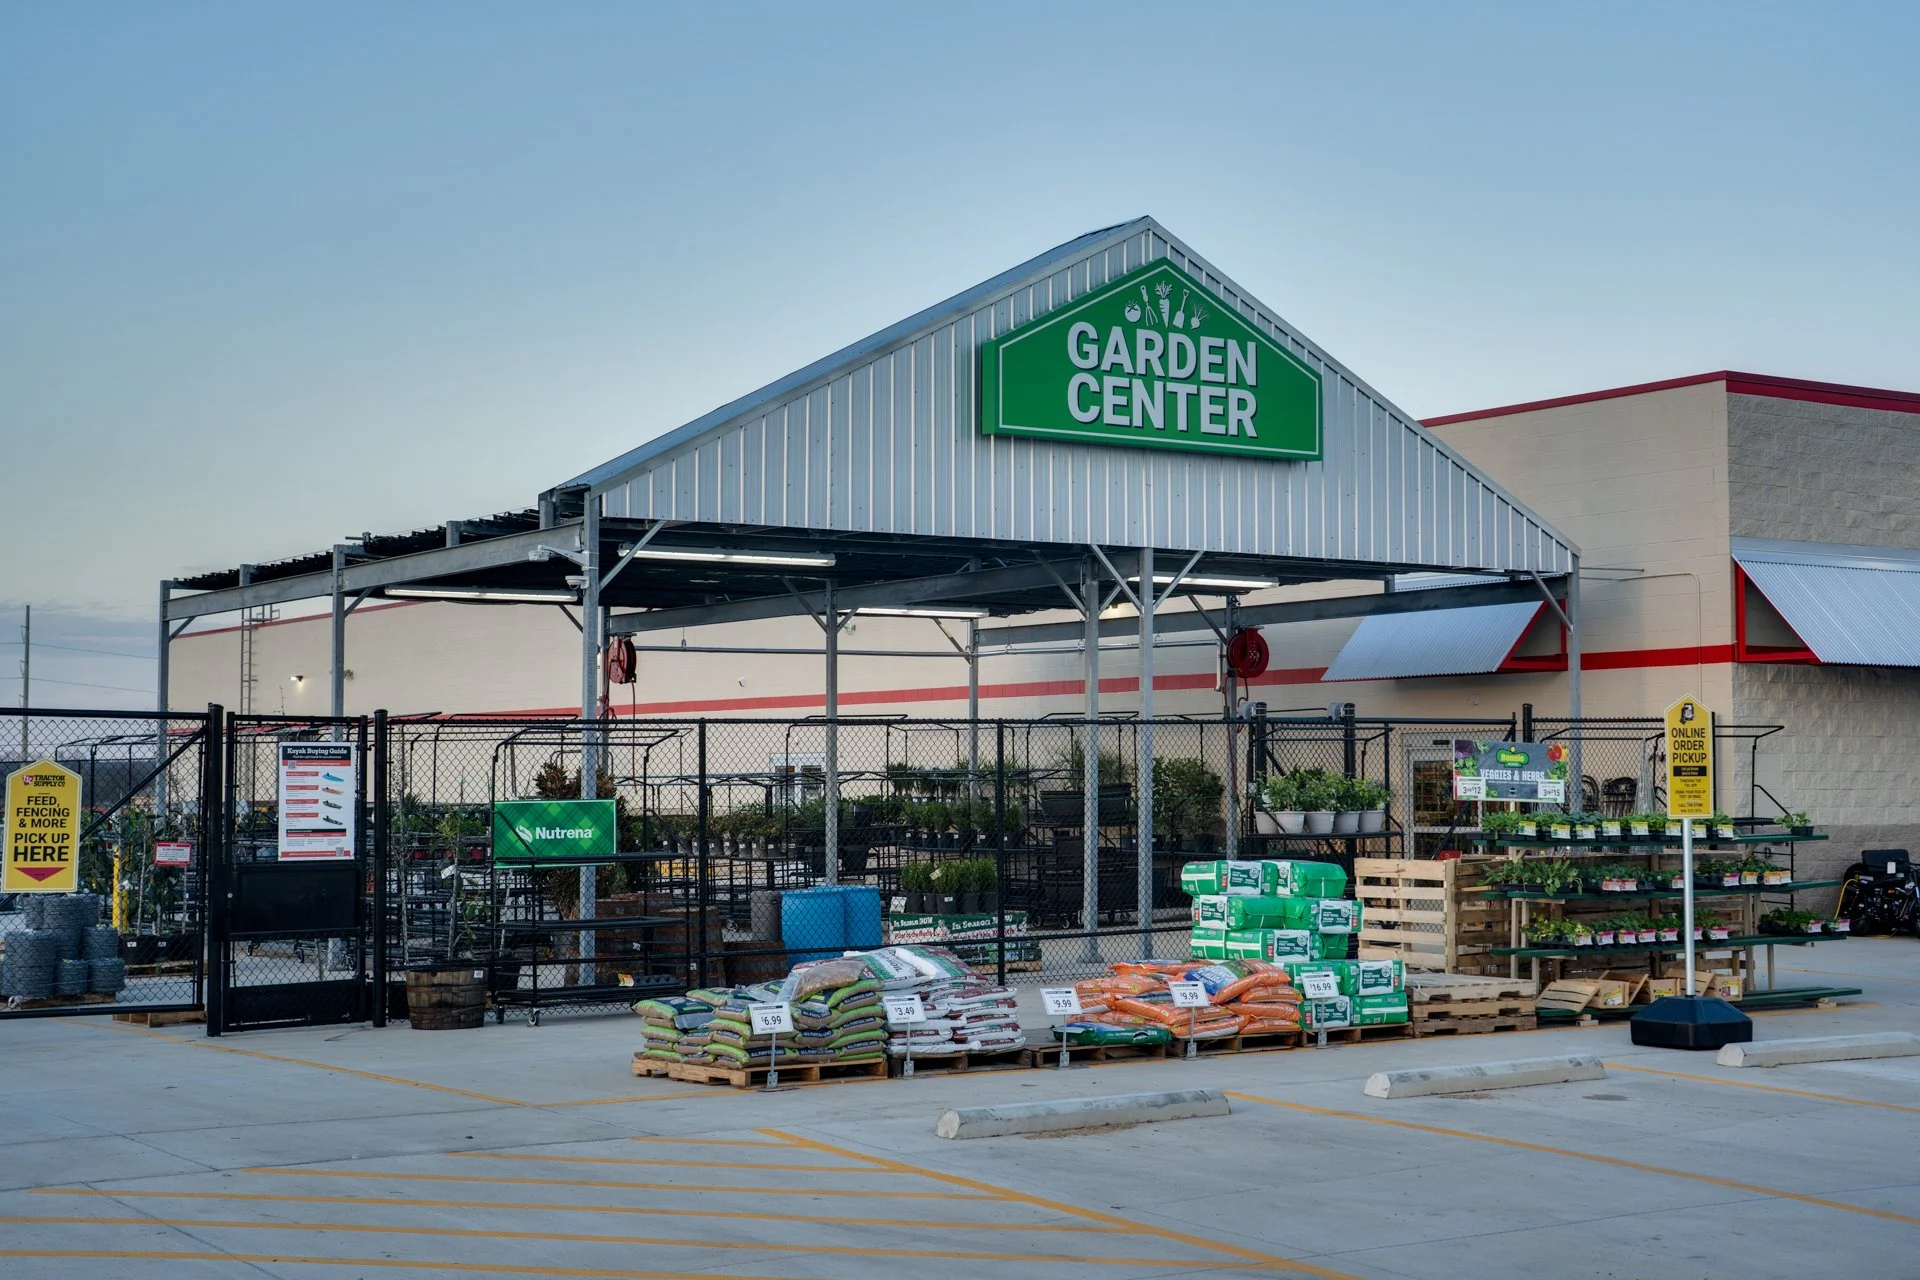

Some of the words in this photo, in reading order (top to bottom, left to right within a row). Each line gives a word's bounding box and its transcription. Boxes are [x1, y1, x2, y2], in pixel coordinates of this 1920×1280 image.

[1067, 322, 1257, 387] GARDEN
[1067, 373, 1258, 438] CENTER
[1672, 728, 1706, 738] ONLINE
[1673, 740, 1704, 751] ORDER
[1672, 752, 1707, 763] PICKUP
[1480, 769, 1511, 780] VEGGIES
[1514, 770, 1519, 780] &
[1522, 771, 1545, 781] HERBS
[27, 796, 60, 807] FEED,
[16, 808, 70, 817] FENCING
[19, 819, 27, 828] &
[31, 819, 66, 828] MORE
[15, 833, 47, 843] PICK
[51, 833, 70, 843] UP
[536, 827, 592, 839] Nutrena
[13, 846, 69, 862] HERE
[962, 920, 991, 929] Season
[992, 915, 1013, 924] NW
[1310, 983, 1331, 992] $16.99
[1180, 992, 1198, 1000] $9.99
[1053, 1000, 1072, 1008] $9.99
[894, 1006, 915, 1016] $3.49
[761, 1015, 782, 1025] $6.99
